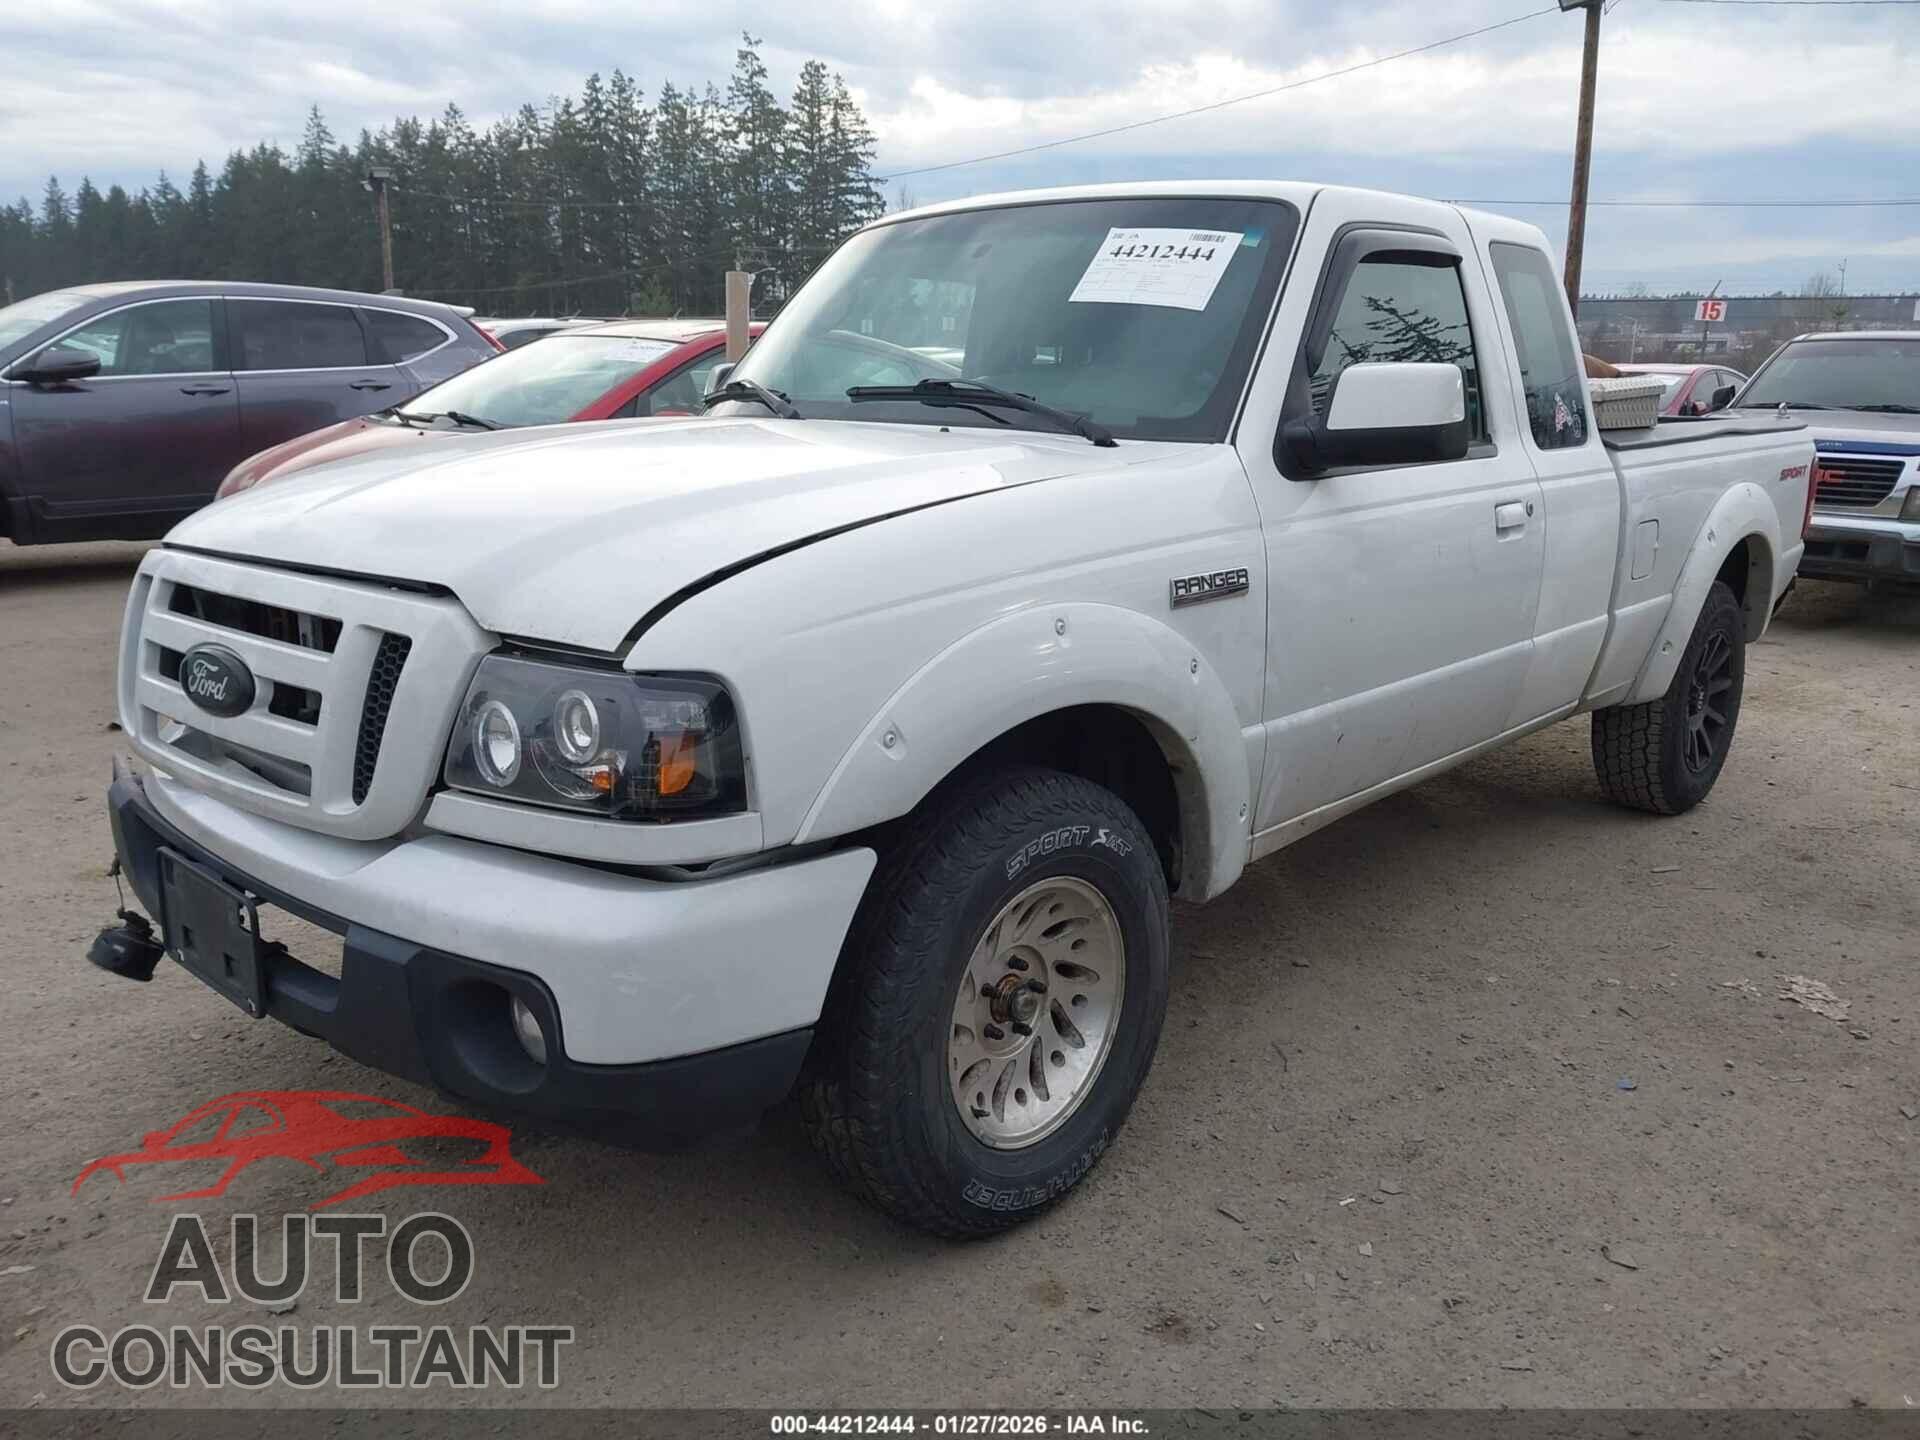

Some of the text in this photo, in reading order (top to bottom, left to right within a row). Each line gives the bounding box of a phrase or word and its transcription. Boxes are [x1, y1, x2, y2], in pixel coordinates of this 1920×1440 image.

[1110, 244, 1215, 261] 44212444
[1701, 302, 1722, 320] 15
[1779, 465, 1808, 481] SPORT
[1173, 568, 1249, 595] RANGER
[187, 659, 228, 701] Ford
[1006, 826, 1090, 880] SPORT
